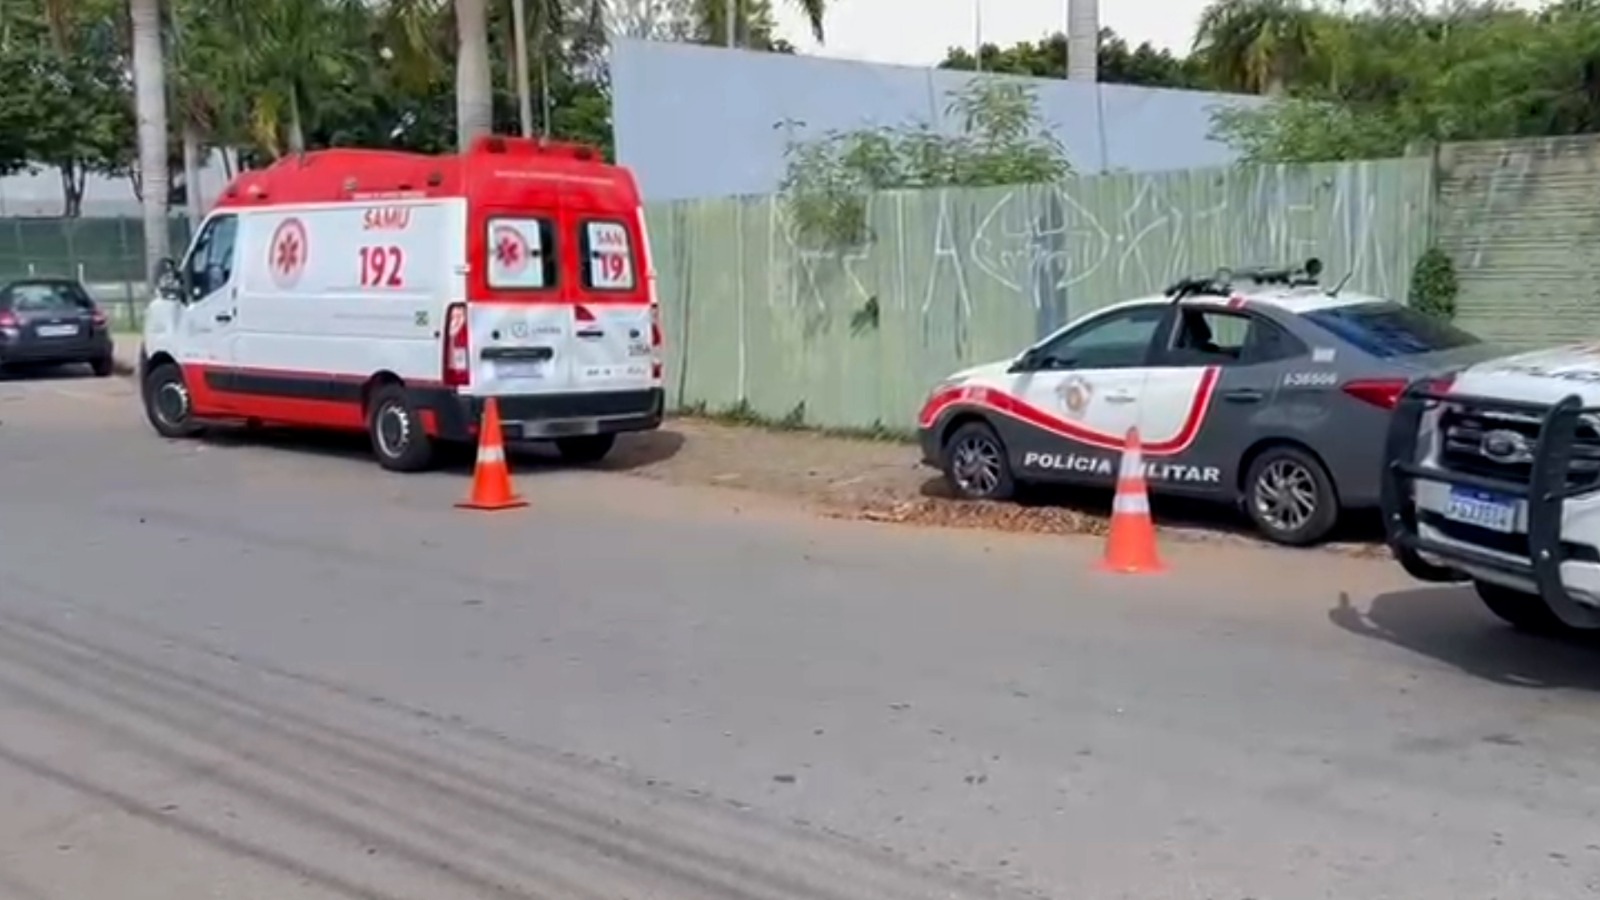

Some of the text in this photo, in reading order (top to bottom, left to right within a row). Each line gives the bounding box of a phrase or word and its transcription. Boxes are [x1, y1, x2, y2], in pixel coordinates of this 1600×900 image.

[363, 207, 410, 230] SAMU
[359, 246, 402, 286] 192
[600, 253, 626, 281] 19
[1024, 452, 1220, 482] POLÍCIA ILITAR
